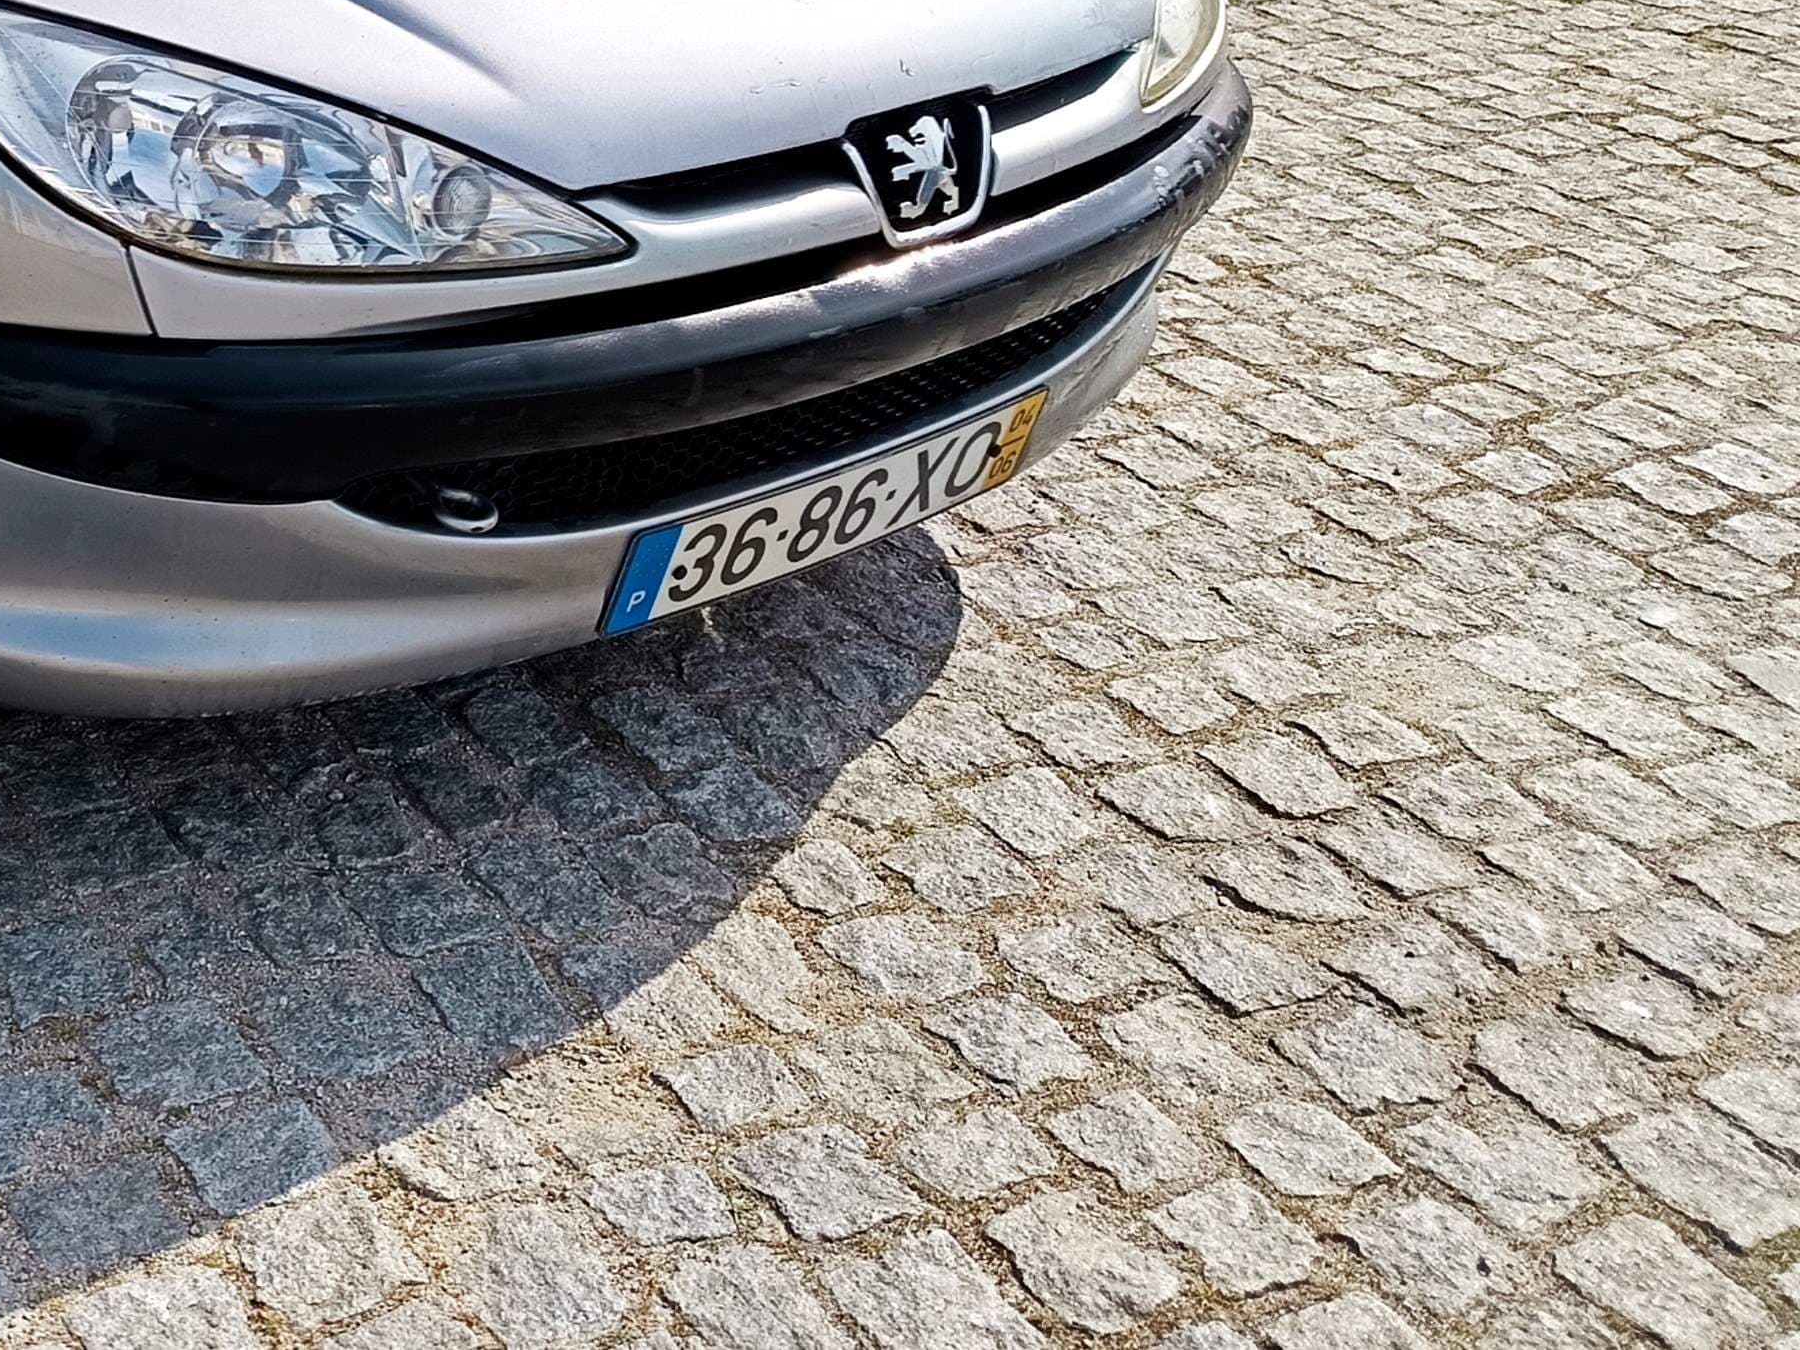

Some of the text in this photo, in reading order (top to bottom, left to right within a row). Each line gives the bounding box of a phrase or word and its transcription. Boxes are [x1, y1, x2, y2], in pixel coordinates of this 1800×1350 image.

[1009, 404, 1036, 433] 04
[988, 450, 1017, 479] 06
[626, 590, 647, 613] P
